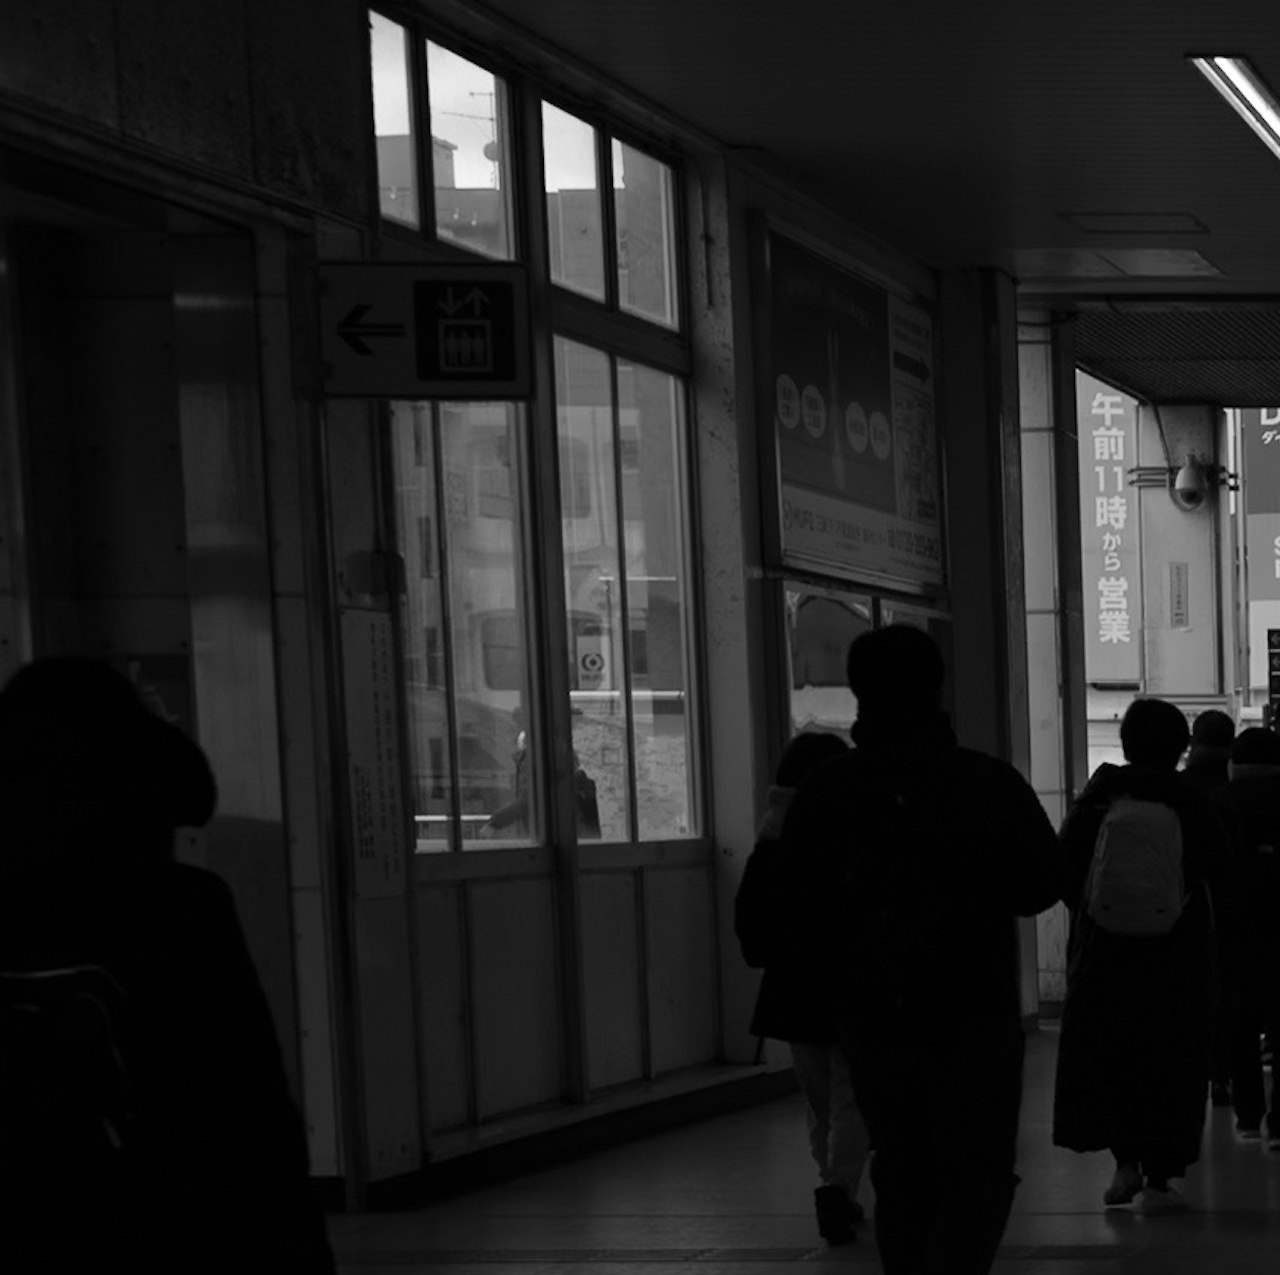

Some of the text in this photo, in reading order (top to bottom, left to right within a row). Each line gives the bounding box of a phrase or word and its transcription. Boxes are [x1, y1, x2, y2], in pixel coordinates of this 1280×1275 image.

[1091, 392, 1131, 644] 午前11時から営業
